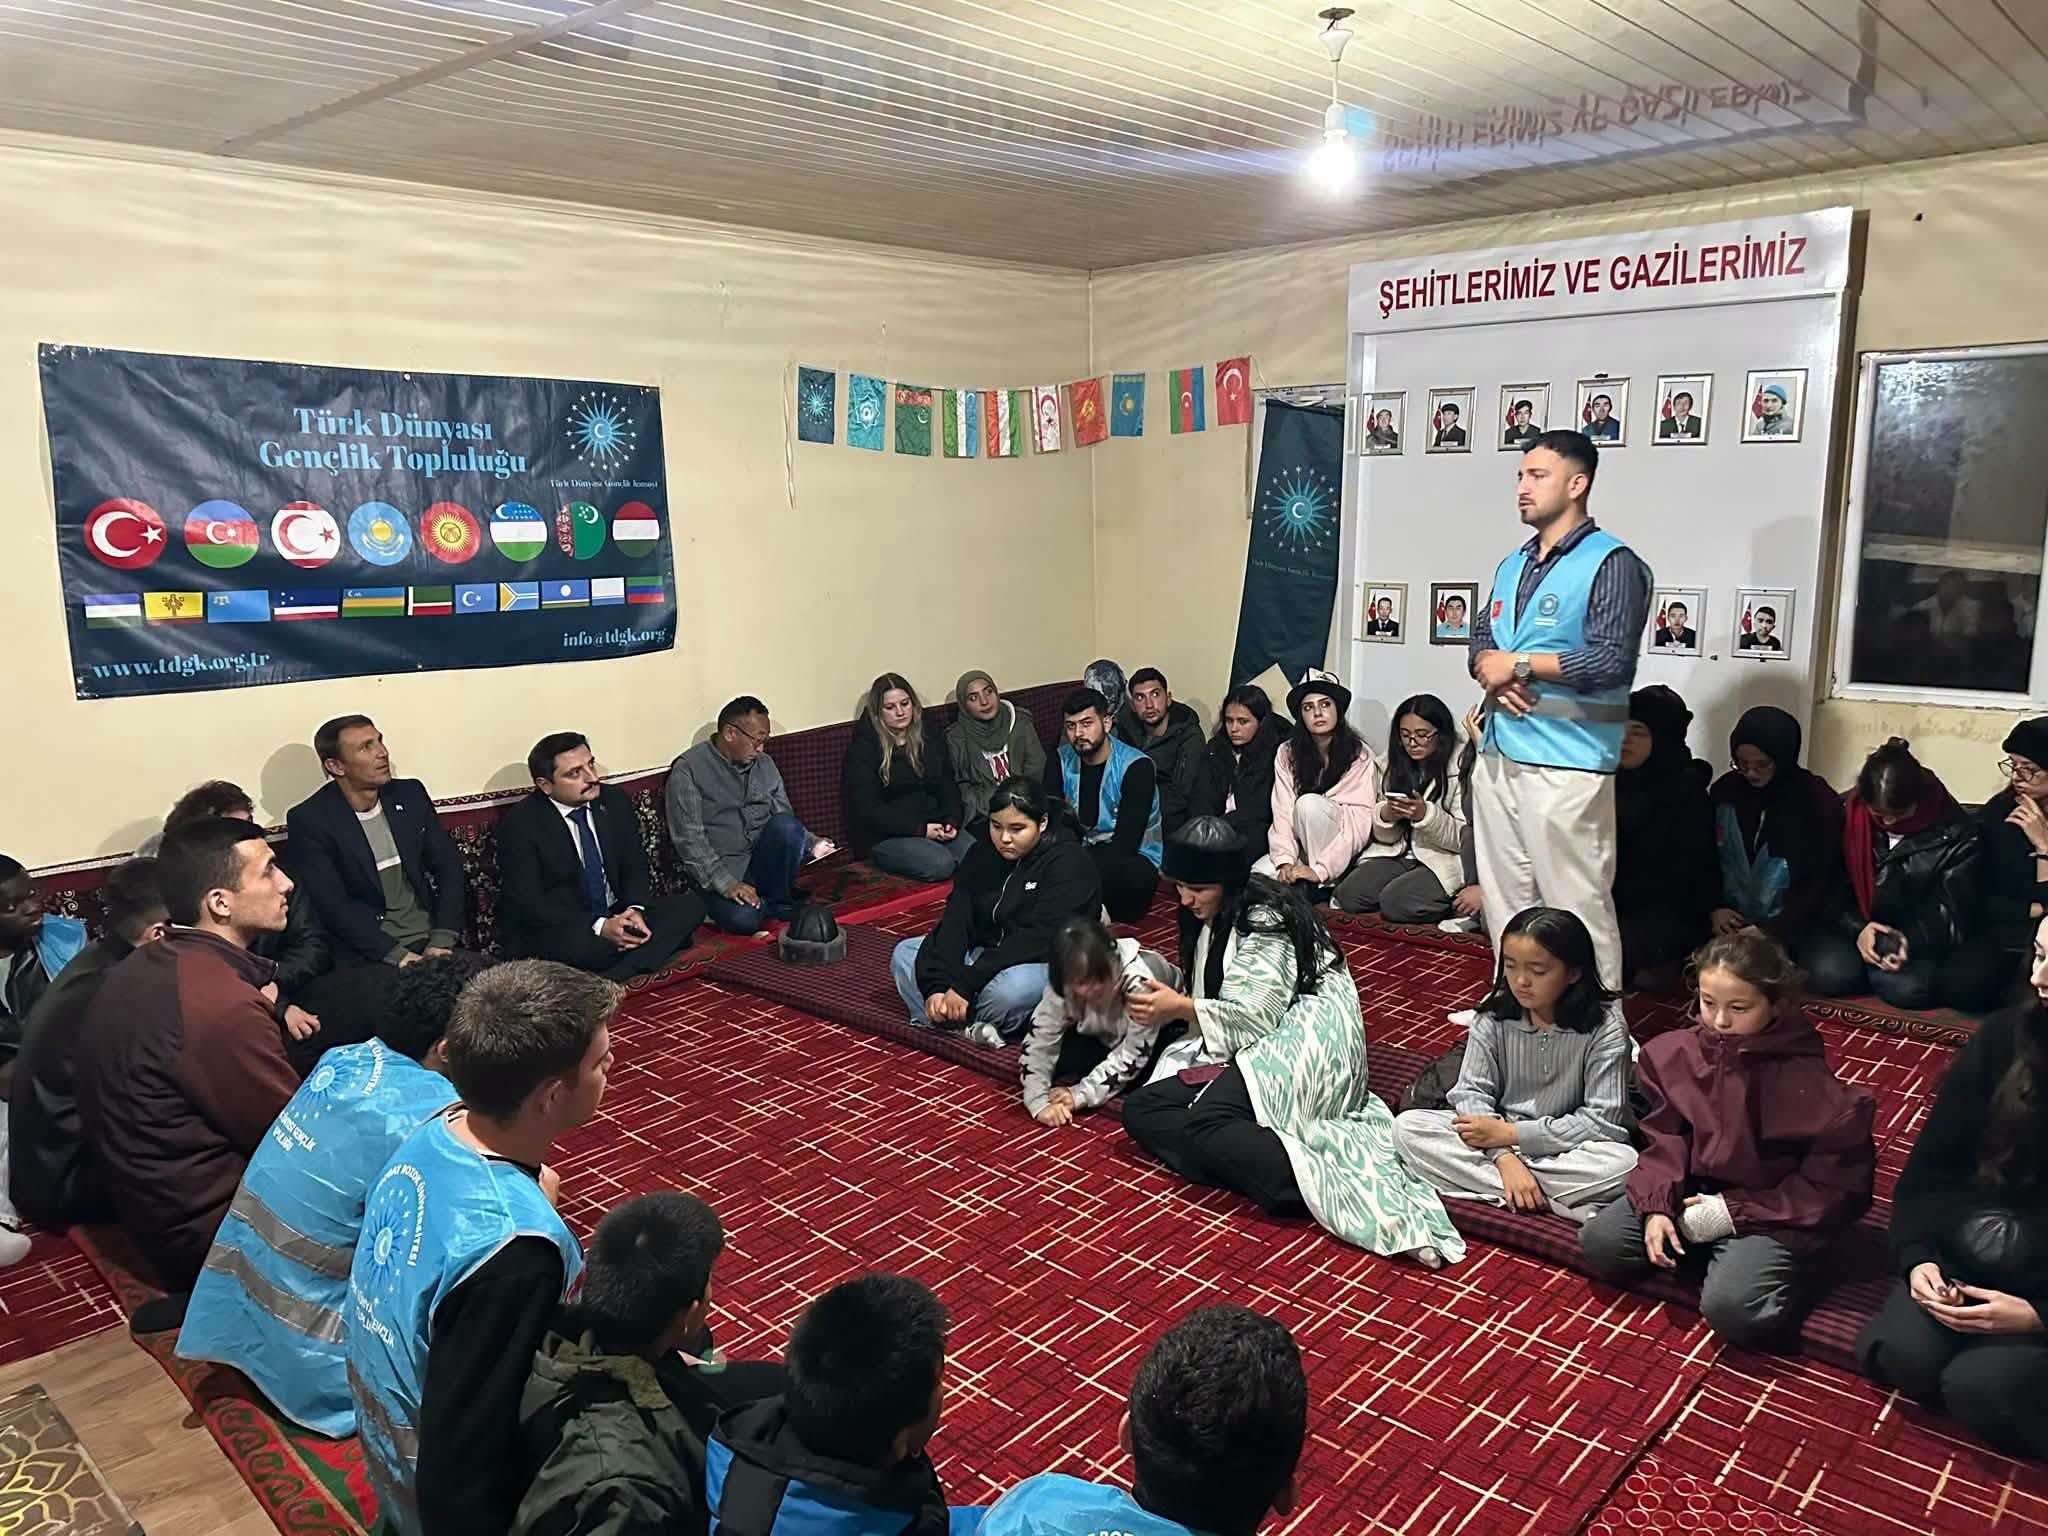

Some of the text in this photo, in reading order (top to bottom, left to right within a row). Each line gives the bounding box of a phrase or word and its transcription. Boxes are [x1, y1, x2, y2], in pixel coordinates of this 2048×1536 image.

[1379, 231, 1808, 319] ŞEHİTLERİMİZ VE GAZİLERİMİZ
[293, 408, 494, 446] Türk Dünyası
[258, 440, 528, 479] Gençlik Topluluğu
[563, 627, 667, 647] info@tdgk.org
[91, 652, 271, 679] www.tdgk.org.tr
